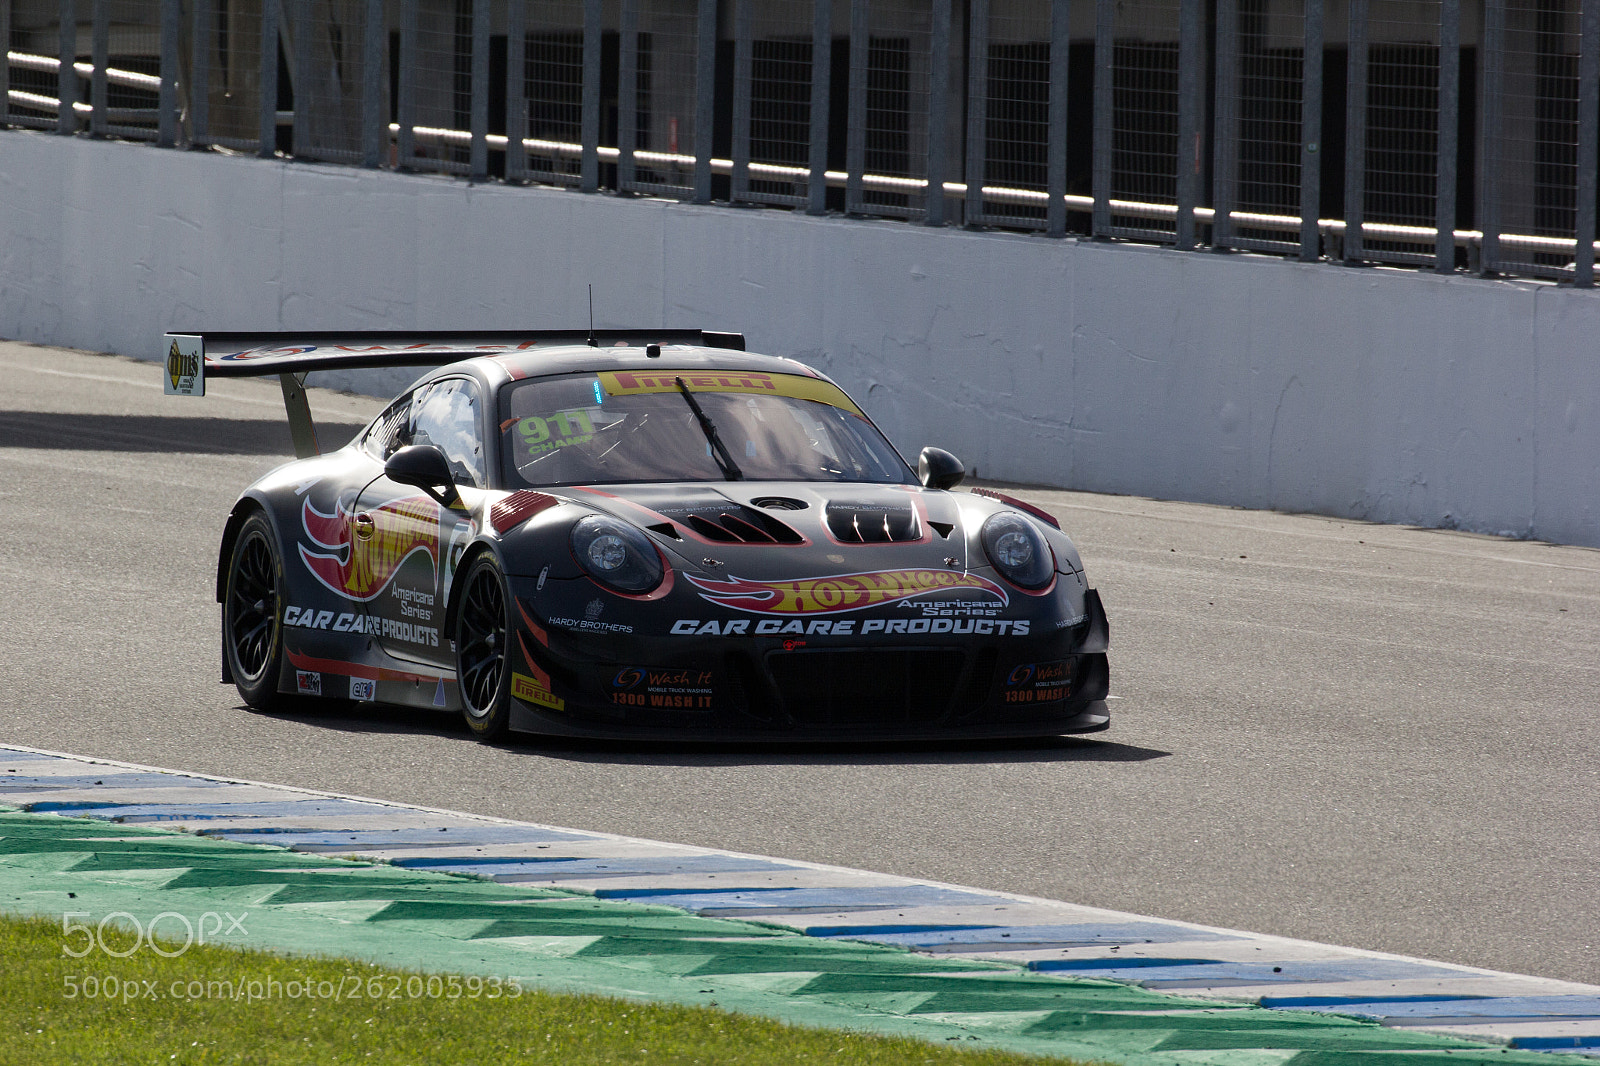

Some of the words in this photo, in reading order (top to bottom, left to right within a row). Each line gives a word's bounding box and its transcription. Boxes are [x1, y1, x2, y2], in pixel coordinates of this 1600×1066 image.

[614, 371, 776, 390] PIRELLI
[518, 408, 595, 444] 911
[528, 434, 593, 454] CHAMP
[391, 581, 434, 606] Americana
[897, 599, 1003, 608] Americana
[283, 605, 334, 630] CAR
[332, 612, 382, 637] CARE
[382, 618, 439, 647] PRODUCTS
[548, 616, 580, 627] HARDY
[580, 620, 633, 634] BROTHERS
[669, 619, 751, 635] CAR
[755, 619, 856, 636] CARE
[860, 618, 1031, 636] PRODUCTS
[649, 671, 689, 685] Wash
[697, 671, 713, 685] It
[515, 677, 559, 705] PIRELLI
[612, 692, 645, 706] 1300
[651, 694, 693, 708] WASH
[699, 695, 713, 708] IT
[1005, 689, 1033, 702] 1300
